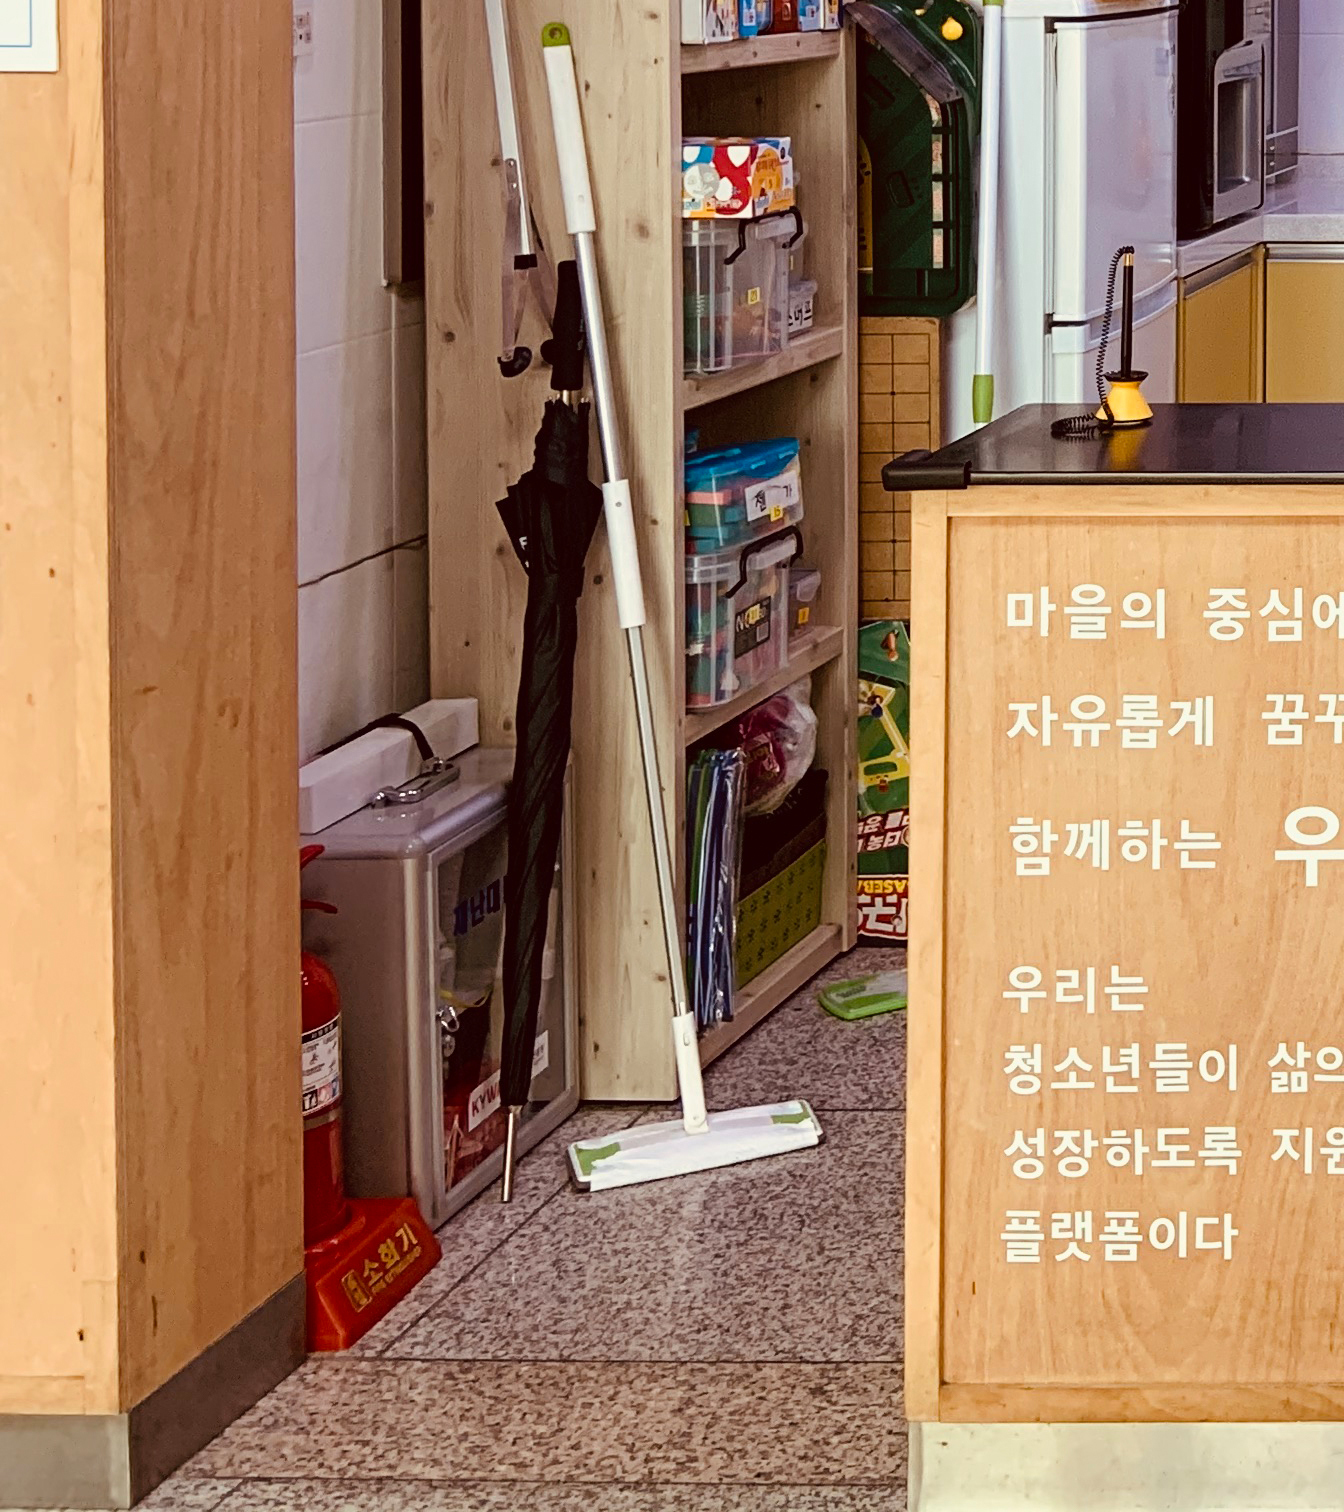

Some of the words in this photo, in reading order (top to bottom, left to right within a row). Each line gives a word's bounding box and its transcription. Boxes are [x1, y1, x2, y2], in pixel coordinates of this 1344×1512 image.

[1007, 583, 1165, 639] 마을의
[1007, 695, 1214, 749] 자유롭게
[1009, 817, 1222, 876] 함께하는
[857, 879, 909, 894] ASEB
[1002, 965, 1148, 1014] 우리는
[1004, 1043, 1237, 1095] 청소년들이
[471, 1083, 501, 1118] KYW
[1004, 1126, 1242, 1179] 성장하도록
[362, 1222, 419, 1287] 소화기
[1000, 1210, 1239, 1263] 플랫폼이다
